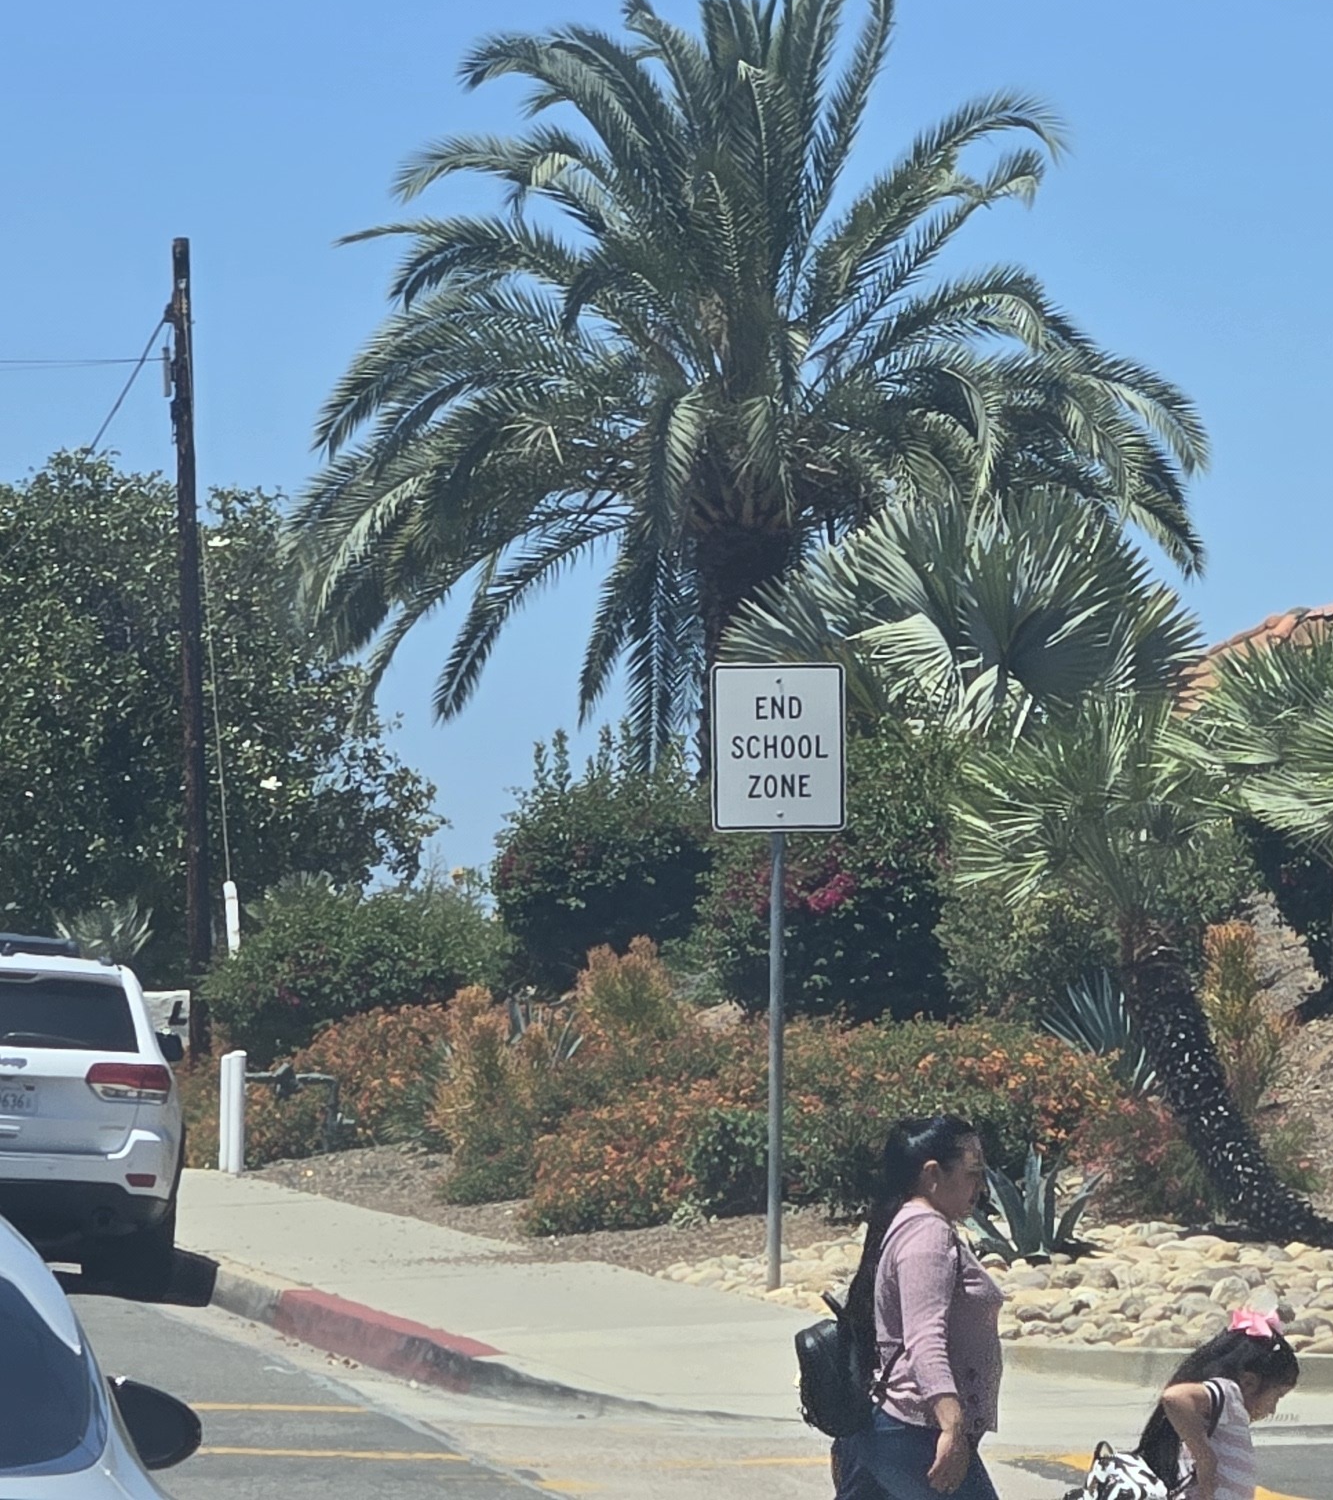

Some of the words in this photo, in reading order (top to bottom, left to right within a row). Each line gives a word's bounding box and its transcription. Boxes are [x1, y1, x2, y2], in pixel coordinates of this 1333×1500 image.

[755, 695, 803, 720] END
[731, 734, 829, 760] SCHOOL
[747, 773, 812, 799] ZONE
